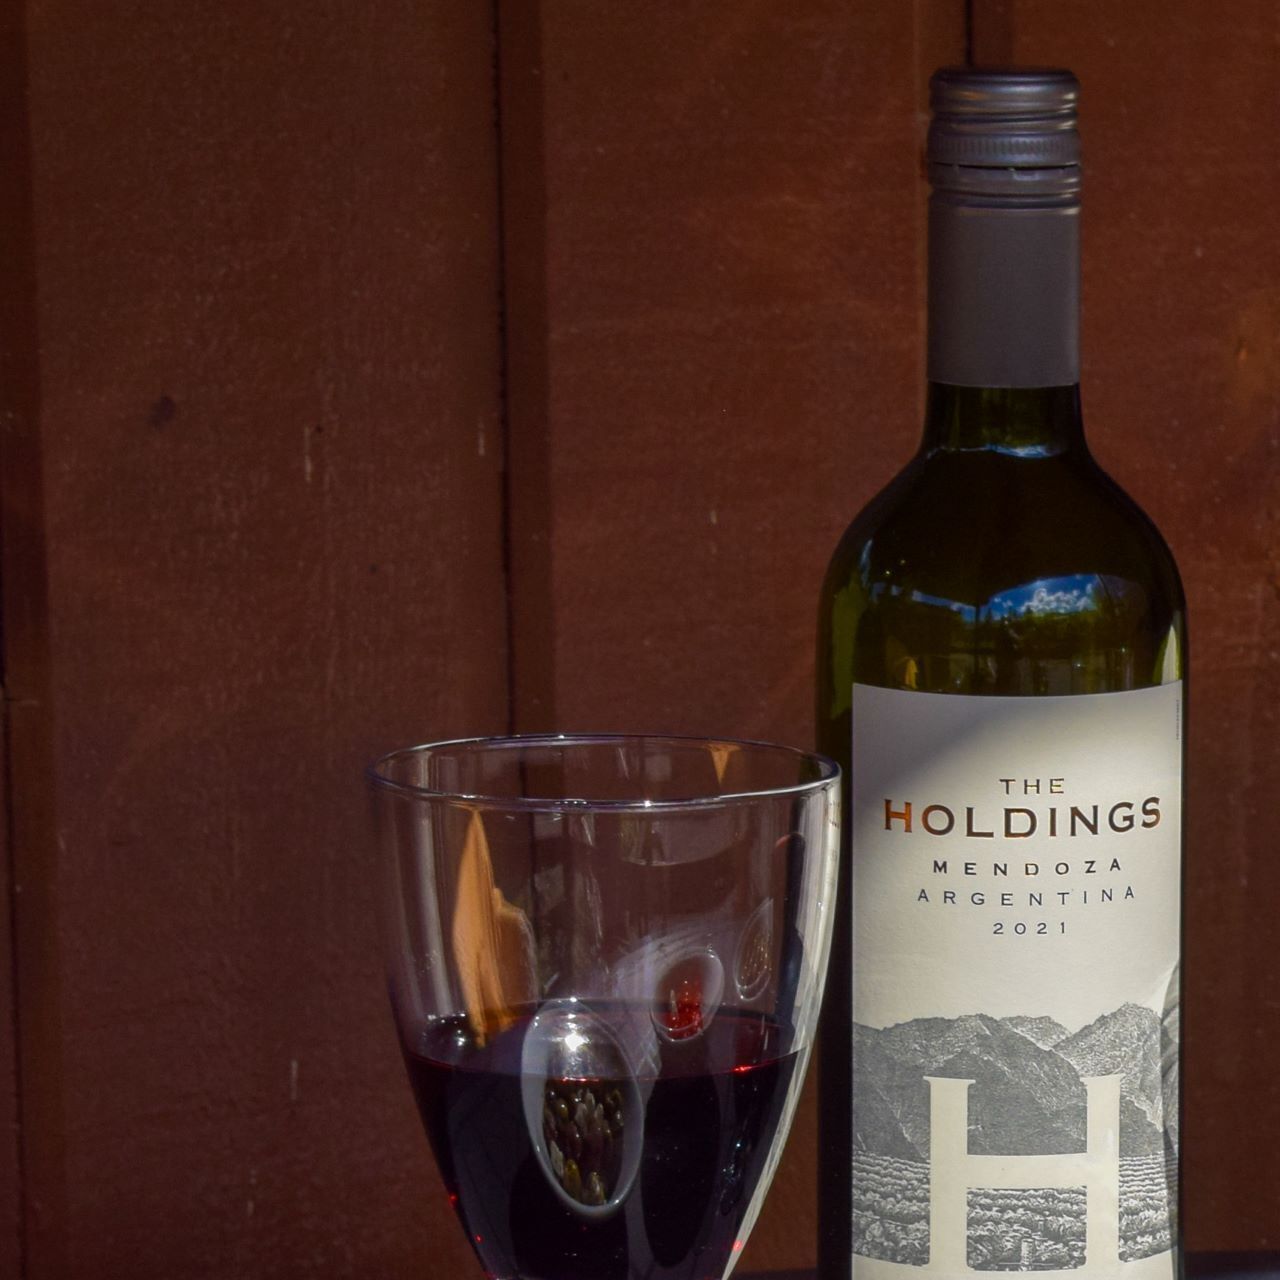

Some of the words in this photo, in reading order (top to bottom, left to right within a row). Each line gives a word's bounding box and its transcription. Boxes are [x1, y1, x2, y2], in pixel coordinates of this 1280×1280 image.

[998, 777, 1065, 795] THE
[884, 796, 1161, 839] HOLDINGS
[932, 857, 1122, 877] MENDOZA
[917, 885, 1135, 907] ARGENTINA
[992, 921, 1066, 936] 2021
[923, 1074, 1125, 1271] H
